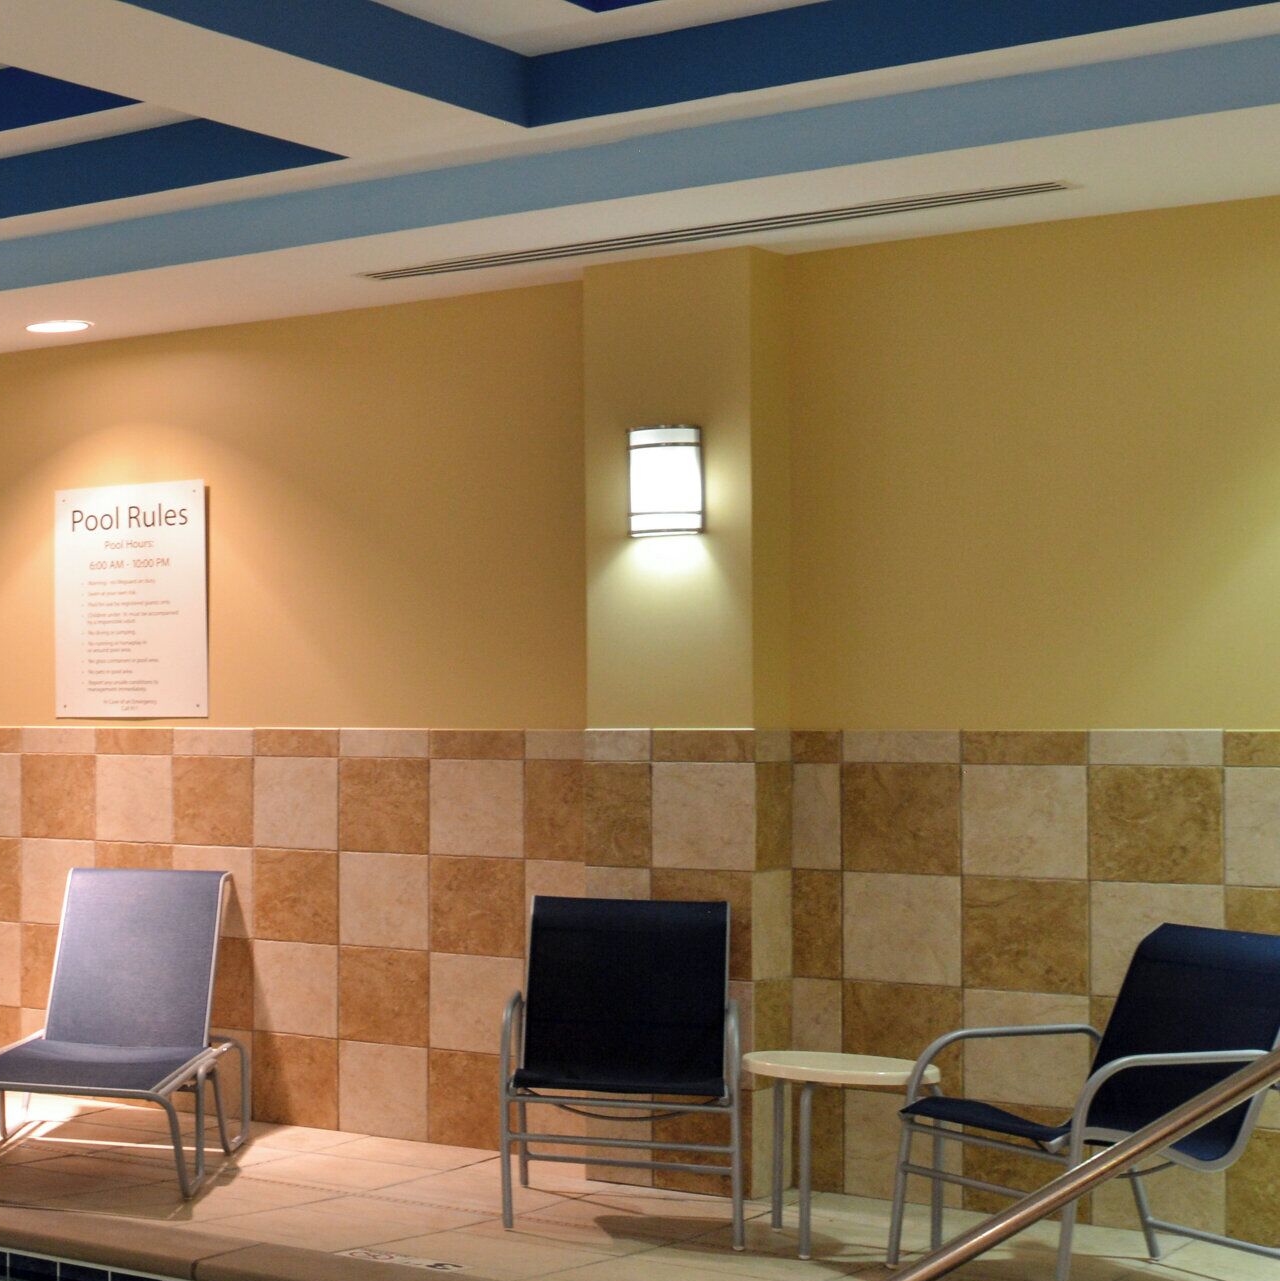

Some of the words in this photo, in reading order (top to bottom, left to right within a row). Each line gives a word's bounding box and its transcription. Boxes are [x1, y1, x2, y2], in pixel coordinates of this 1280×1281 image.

[72, 506, 119, 532] Pool
[128, 502, 189, 529] Rules
[110, 559, 125, 569] AM
[156, 557, 171, 568] PM
